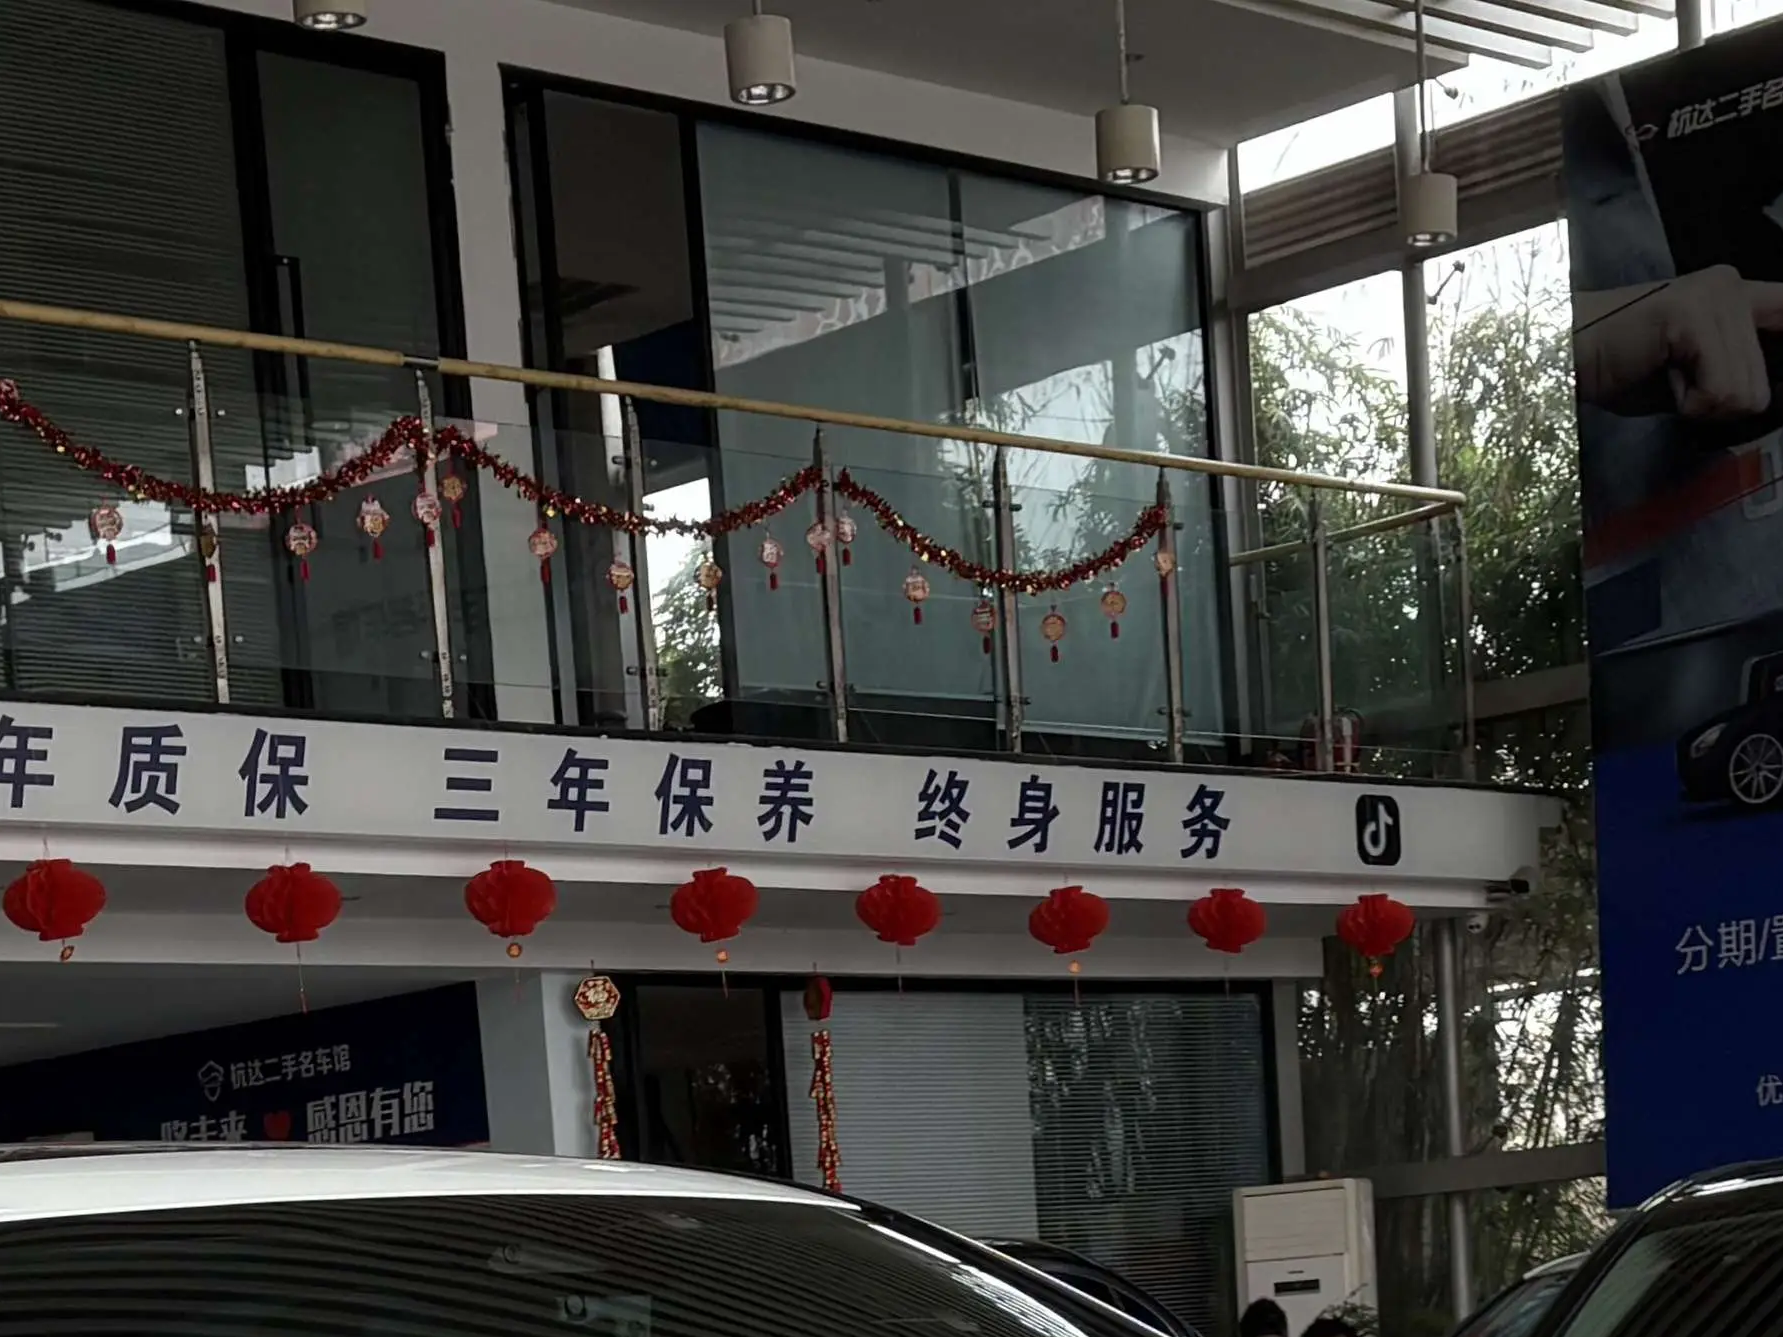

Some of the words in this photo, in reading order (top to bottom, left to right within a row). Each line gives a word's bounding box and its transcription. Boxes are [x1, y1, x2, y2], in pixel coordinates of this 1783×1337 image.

[434, 746, 816, 844] 三年保养
[914, 768, 1231, 860] 终身服务
[230, 1044, 351, 1090] 杭达二手名车馆
[306, 1080, 435, 1143] 感恩有您
